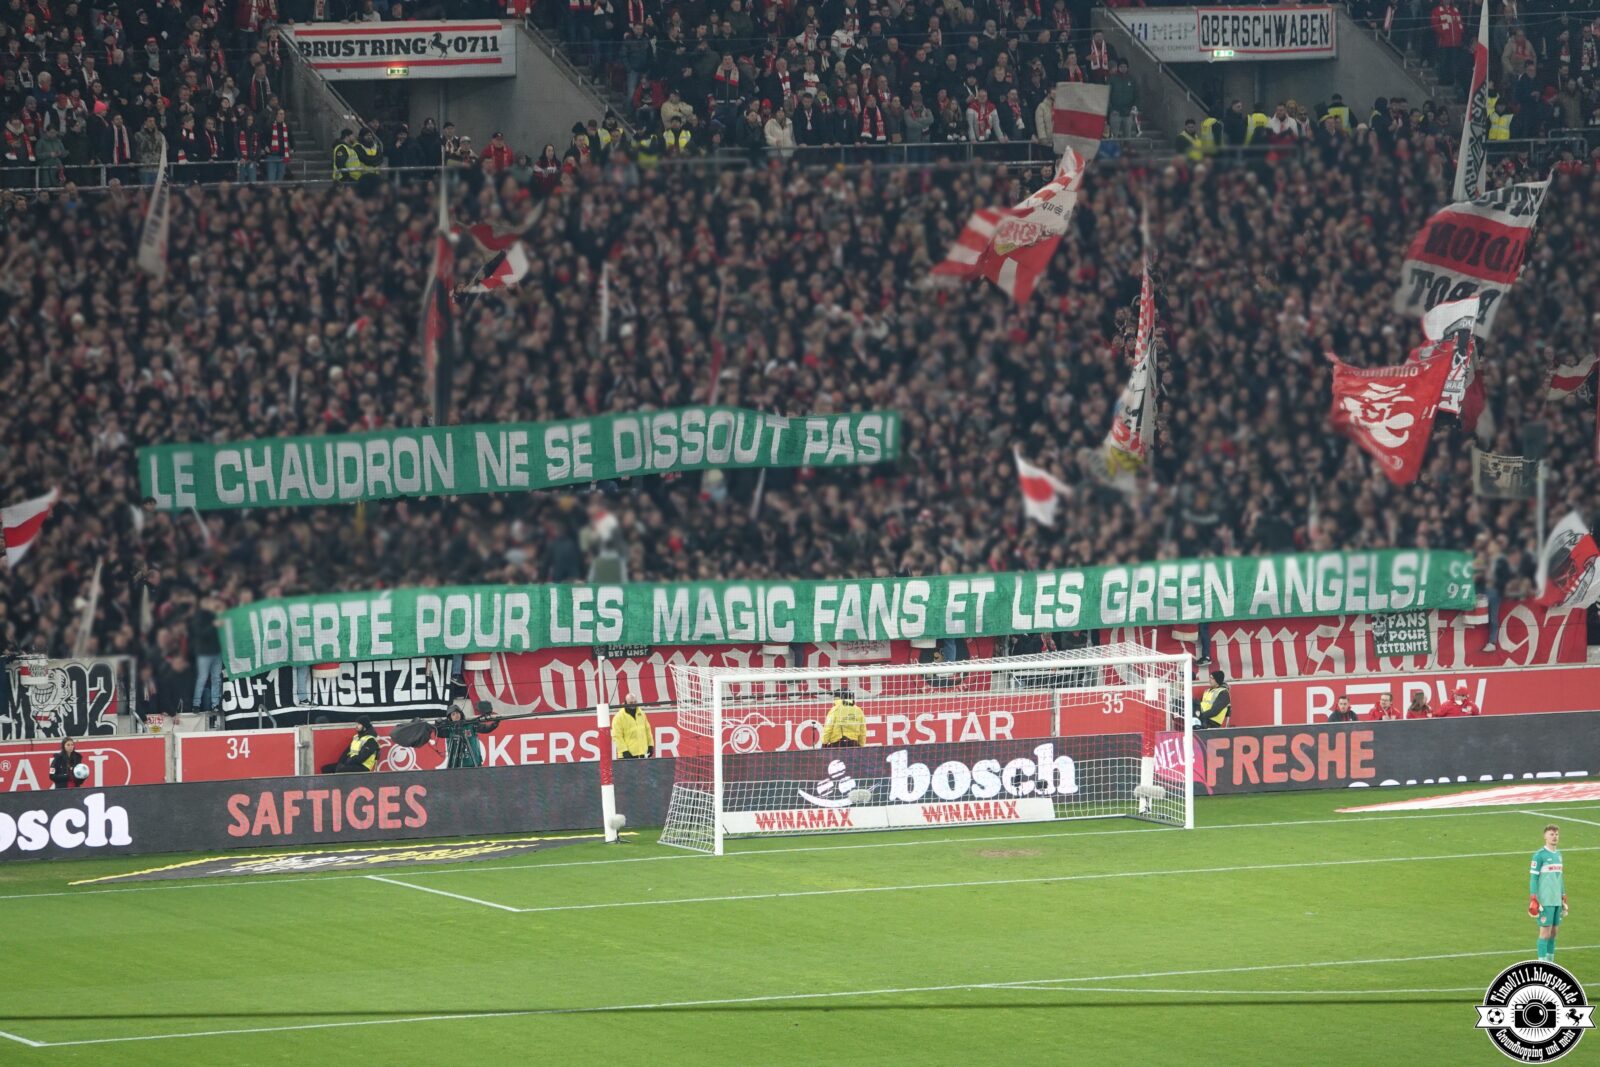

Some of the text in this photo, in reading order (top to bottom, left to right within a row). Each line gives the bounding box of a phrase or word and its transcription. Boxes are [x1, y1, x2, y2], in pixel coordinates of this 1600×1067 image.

[1201, 13, 1330, 47] OBERSCHWABEN
[297, 35, 499, 57] BRUSTRING 0711
[150, 410, 895, 510] LE CHAUDRON NE SE DISSOUT PAS!
[1449, 561, 1473, 578] CC
[1447, 584, 1472, 599] 97
[225, 550, 1431, 674] LIBERTÉ POUR LES MAGIC FANS ET LES GREEN ANGELS!
[1388, 612, 1427, 628] FANS
[1388, 629, 1427, 641] POUR
[1498, 604, 1573, 667] 97
[292, 657, 453, 707] UMSETZEN!
[1102, 693, 1124, 714] 35
[776, 711, 1015, 751] JOERSTAR
[226, 738, 251, 760] 34
[1207, 730, 1376, 786] FRESHE
[886, 743, 1078, 802] bosch
[227, 785, 428, 837] SAFTIGES
[755, 808, 854, 831] WINAMAX
[921, 800, 1020, 824] WINAMAX
